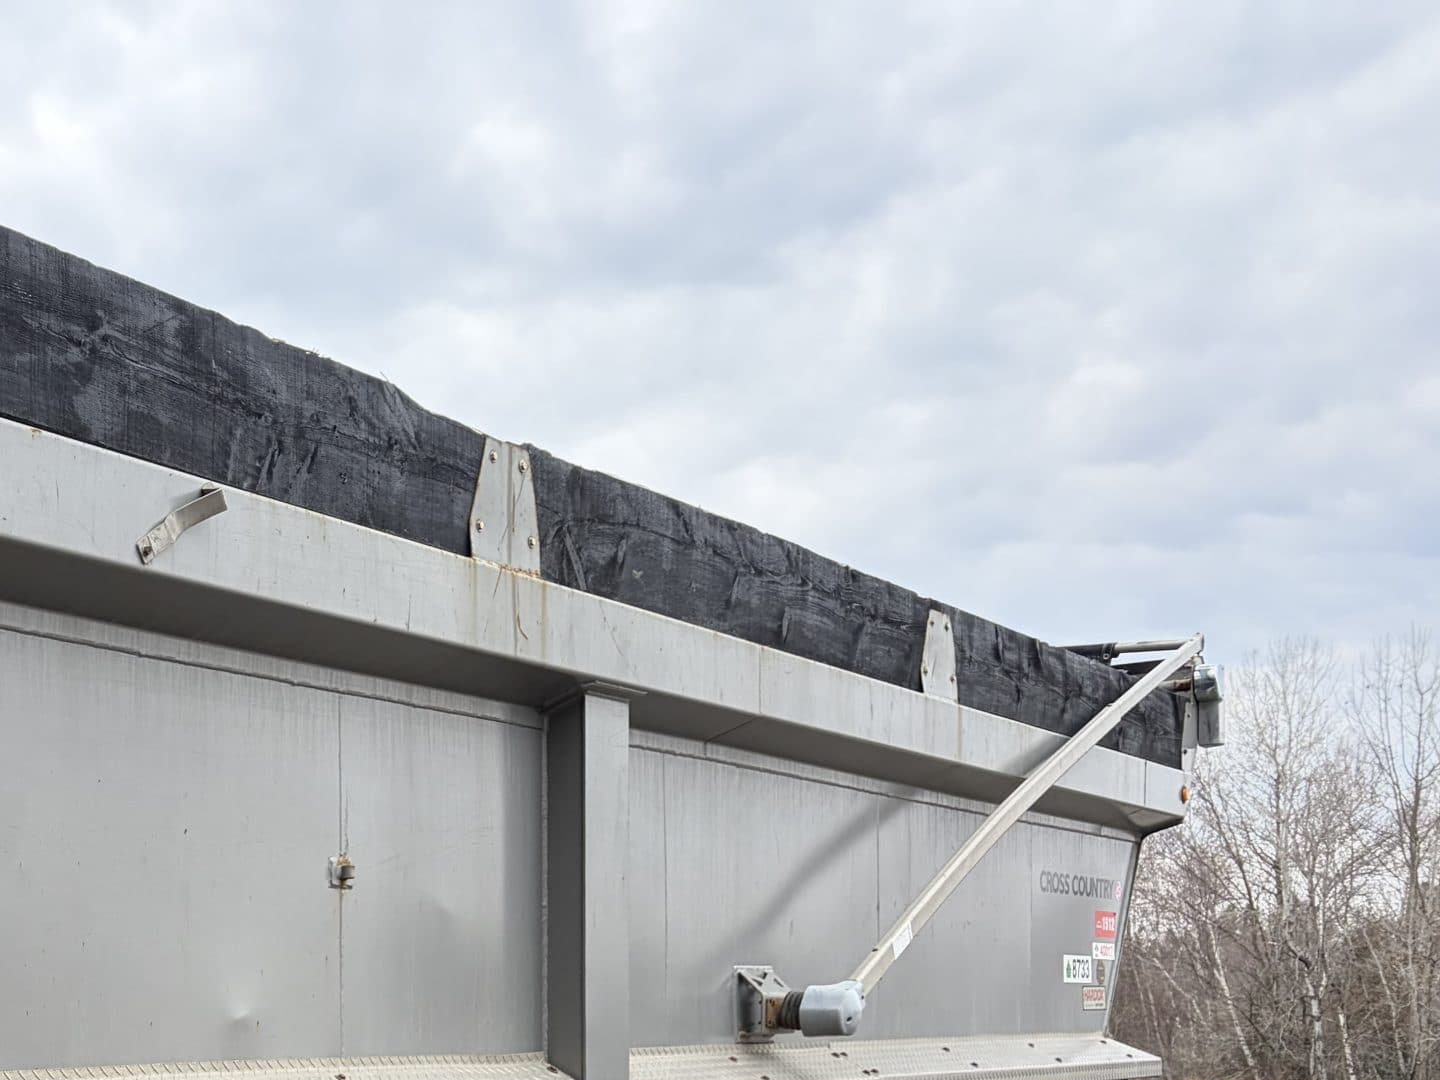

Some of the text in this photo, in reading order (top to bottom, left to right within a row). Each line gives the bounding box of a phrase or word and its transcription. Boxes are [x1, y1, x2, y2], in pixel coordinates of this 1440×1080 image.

[1040, 870, 1114, 900] CROSS COUNTRY
[1072, 958, 1090, 979] 8733
